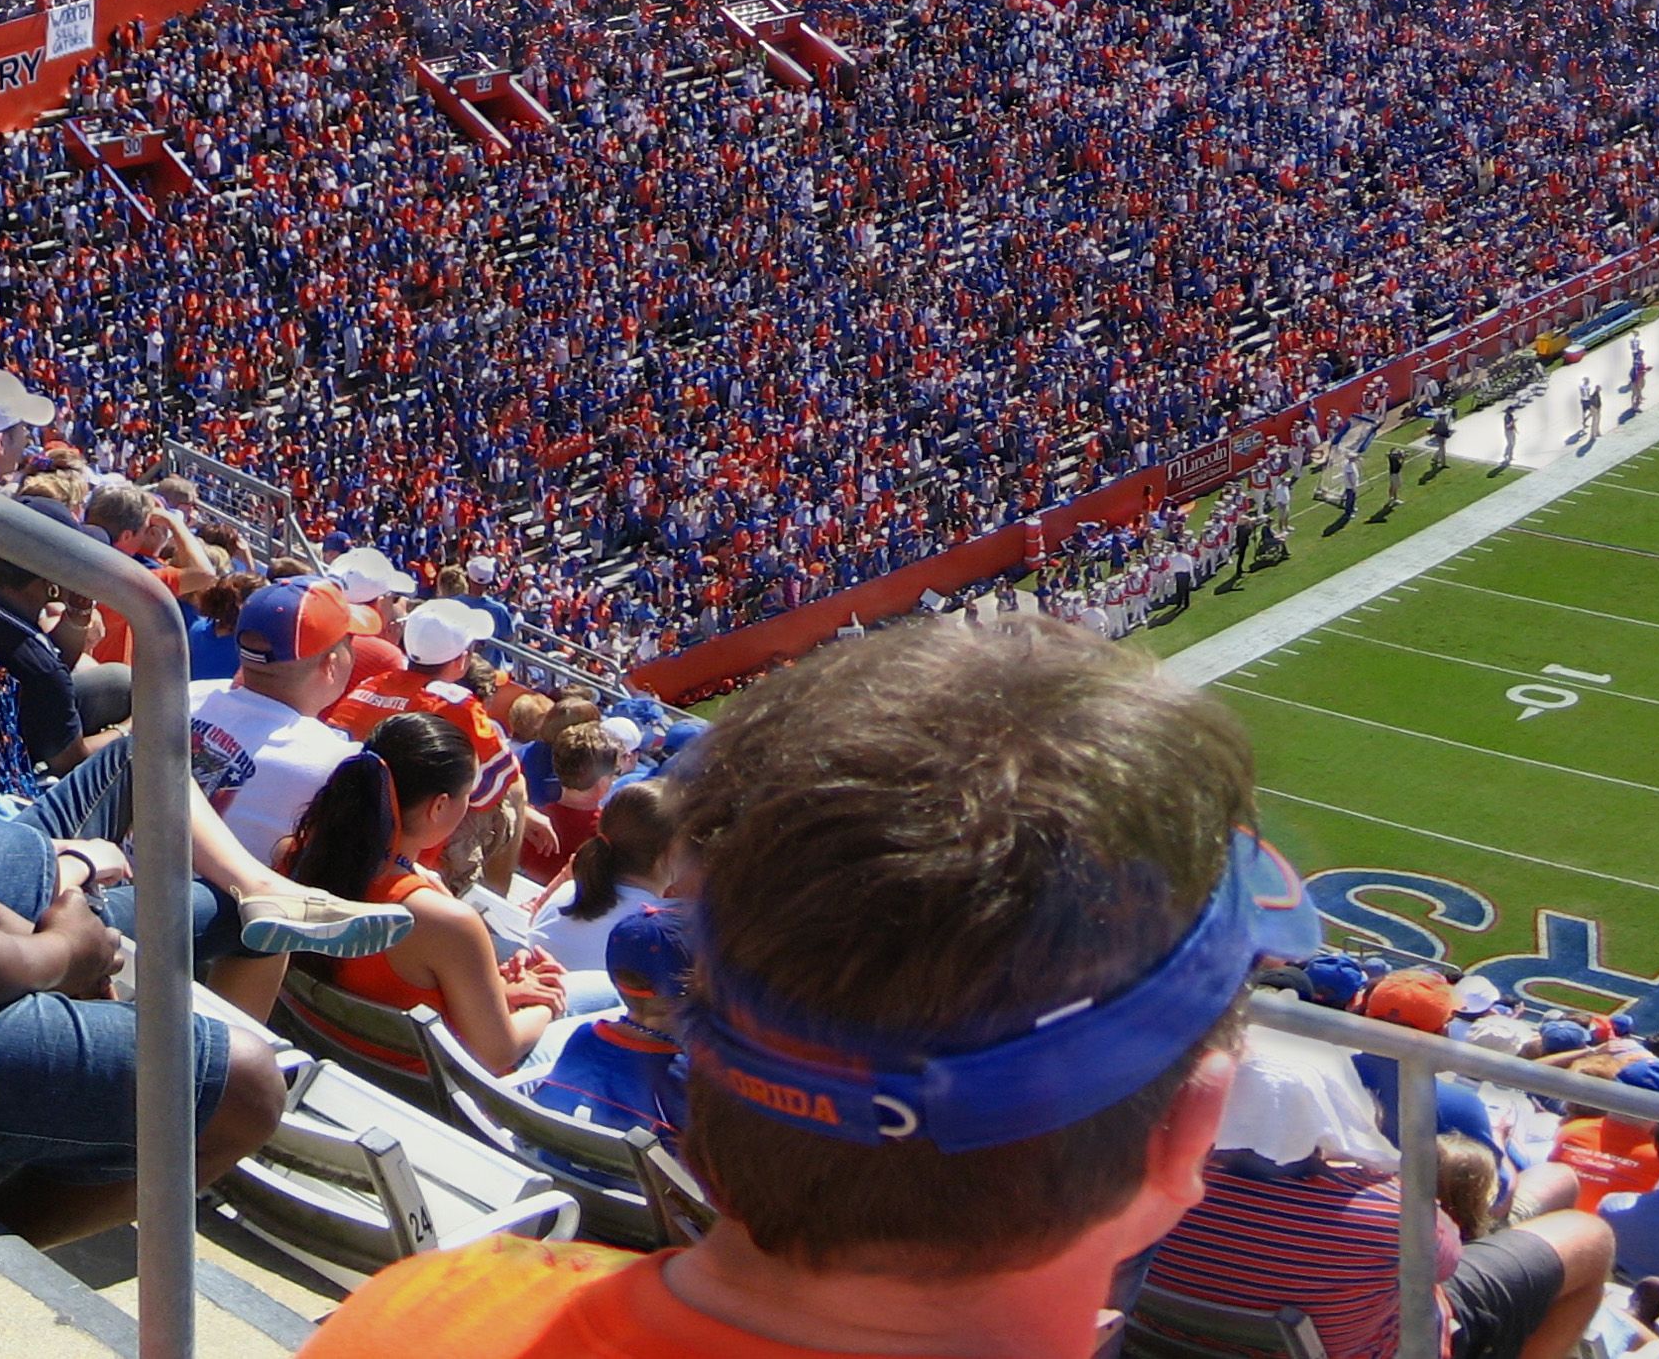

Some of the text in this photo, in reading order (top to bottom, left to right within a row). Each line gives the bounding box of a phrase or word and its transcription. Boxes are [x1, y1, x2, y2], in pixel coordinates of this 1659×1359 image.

[477, 78, 492, 91] 32
[124, 138, 140, 153] 30
[1182, 444, 1228, 473] Lincoln
[1506, 663, 1612, 712] 10
[408, 1210, 434, 1242] 24
